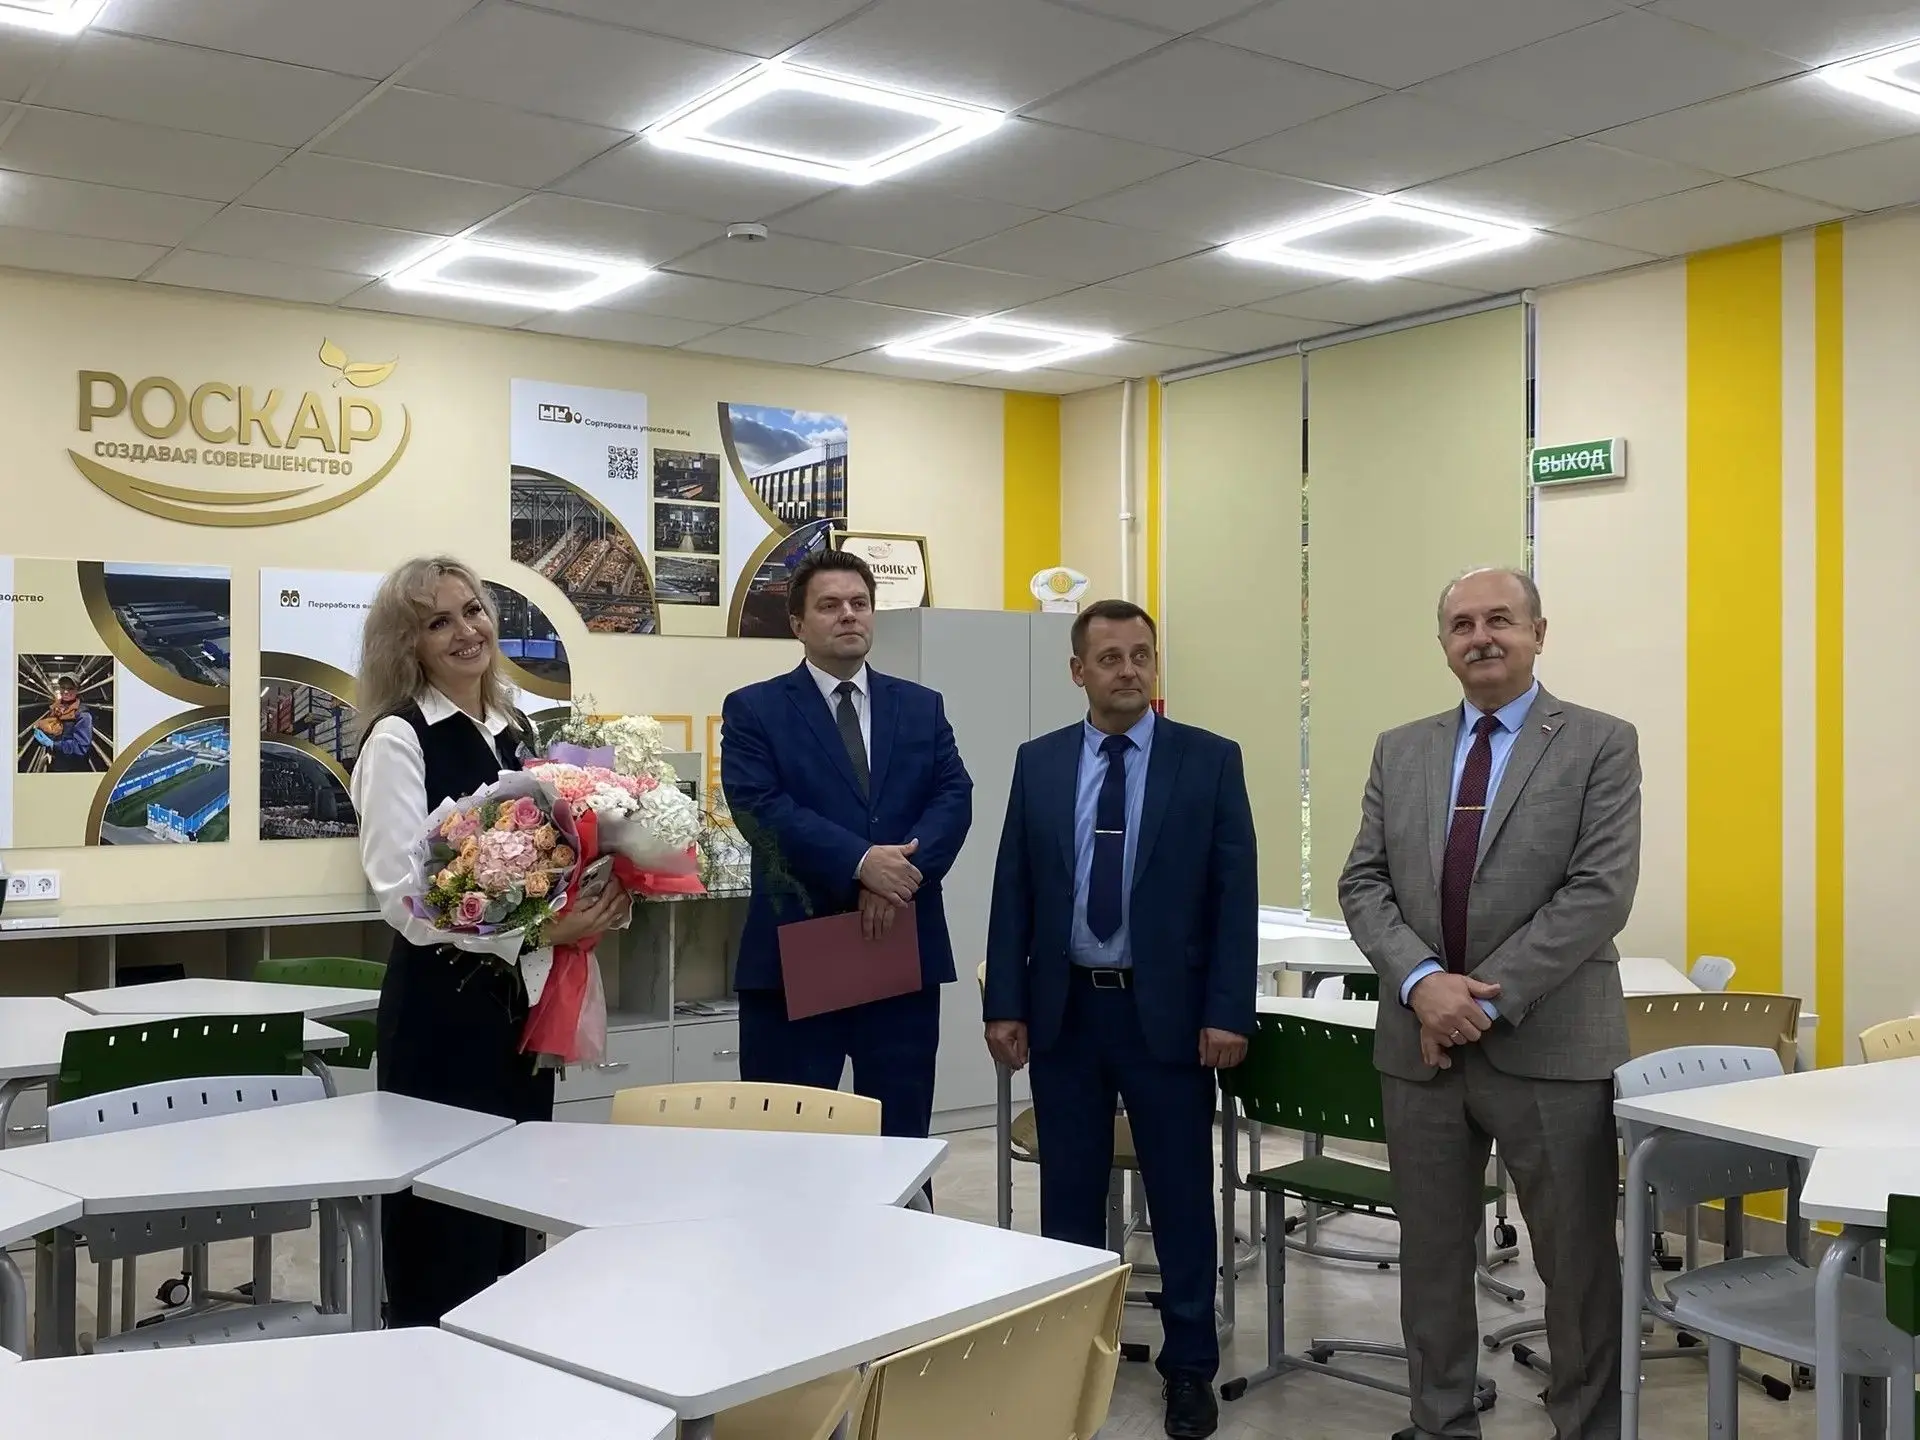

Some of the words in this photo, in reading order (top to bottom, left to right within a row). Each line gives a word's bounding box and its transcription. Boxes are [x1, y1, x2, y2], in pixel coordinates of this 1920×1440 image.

[78, 370, 383, 454] РОСКАР
[584, 418, 632, 430] Сортировка
[639, 425, 675, 435] упаковка
[94, 441, 198, 464] СОЗДАВАЯ
[202, 449, 353, 476] СОВЕРШЕНСТВО
[1539, 449, 1605, 474] ВЫХОД
[308, 600, 361, 609] Переработка
